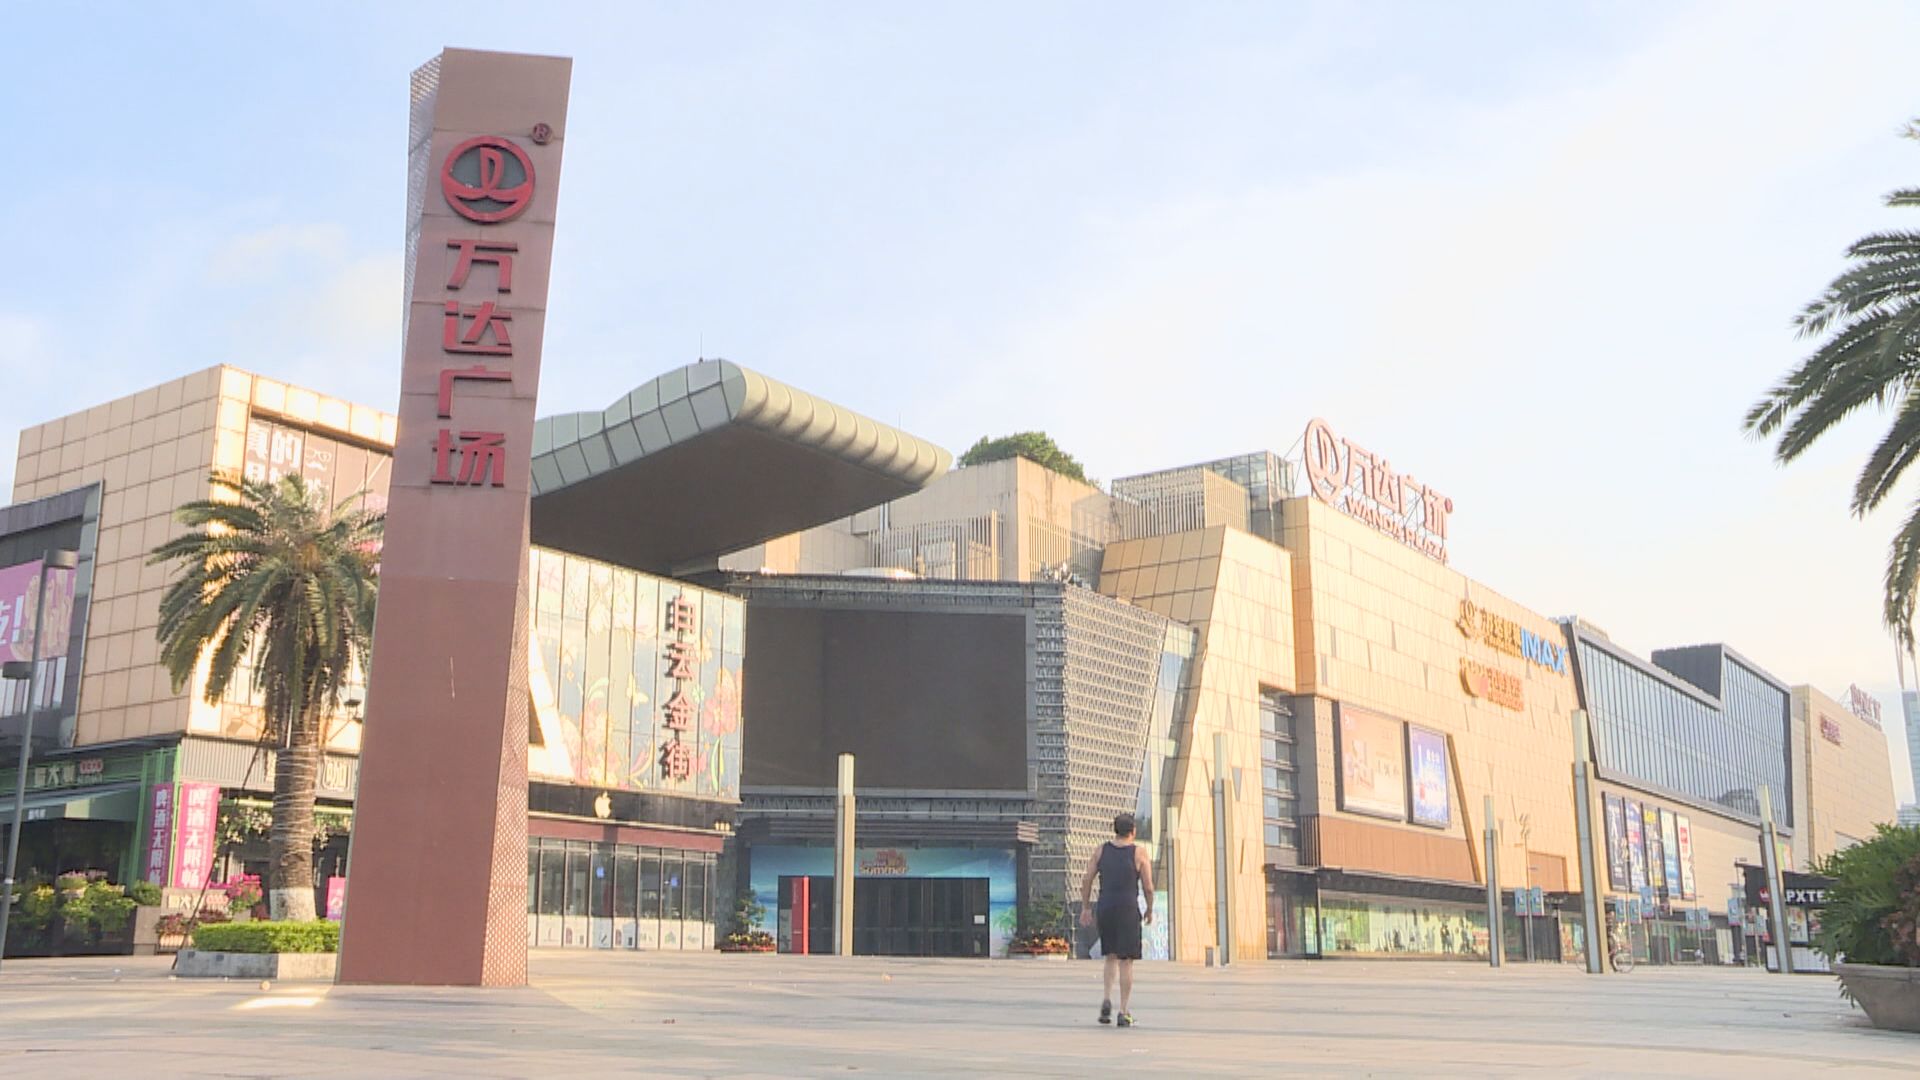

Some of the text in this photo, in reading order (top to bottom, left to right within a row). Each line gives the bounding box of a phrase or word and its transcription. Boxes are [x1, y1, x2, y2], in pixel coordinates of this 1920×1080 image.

[430, 238, 518, 488] 万达广场
[246, 422, 302, 469] 真的
[1342, 437, 1449, 540] 万达广场
[1345, 495, 1449, 564] WANDA PLAZA
[1520, 627, 1568, 677] IMAX
[660, 594, 698, 781] 白云金街
[1784, 888, 1836, 903] PXTE
